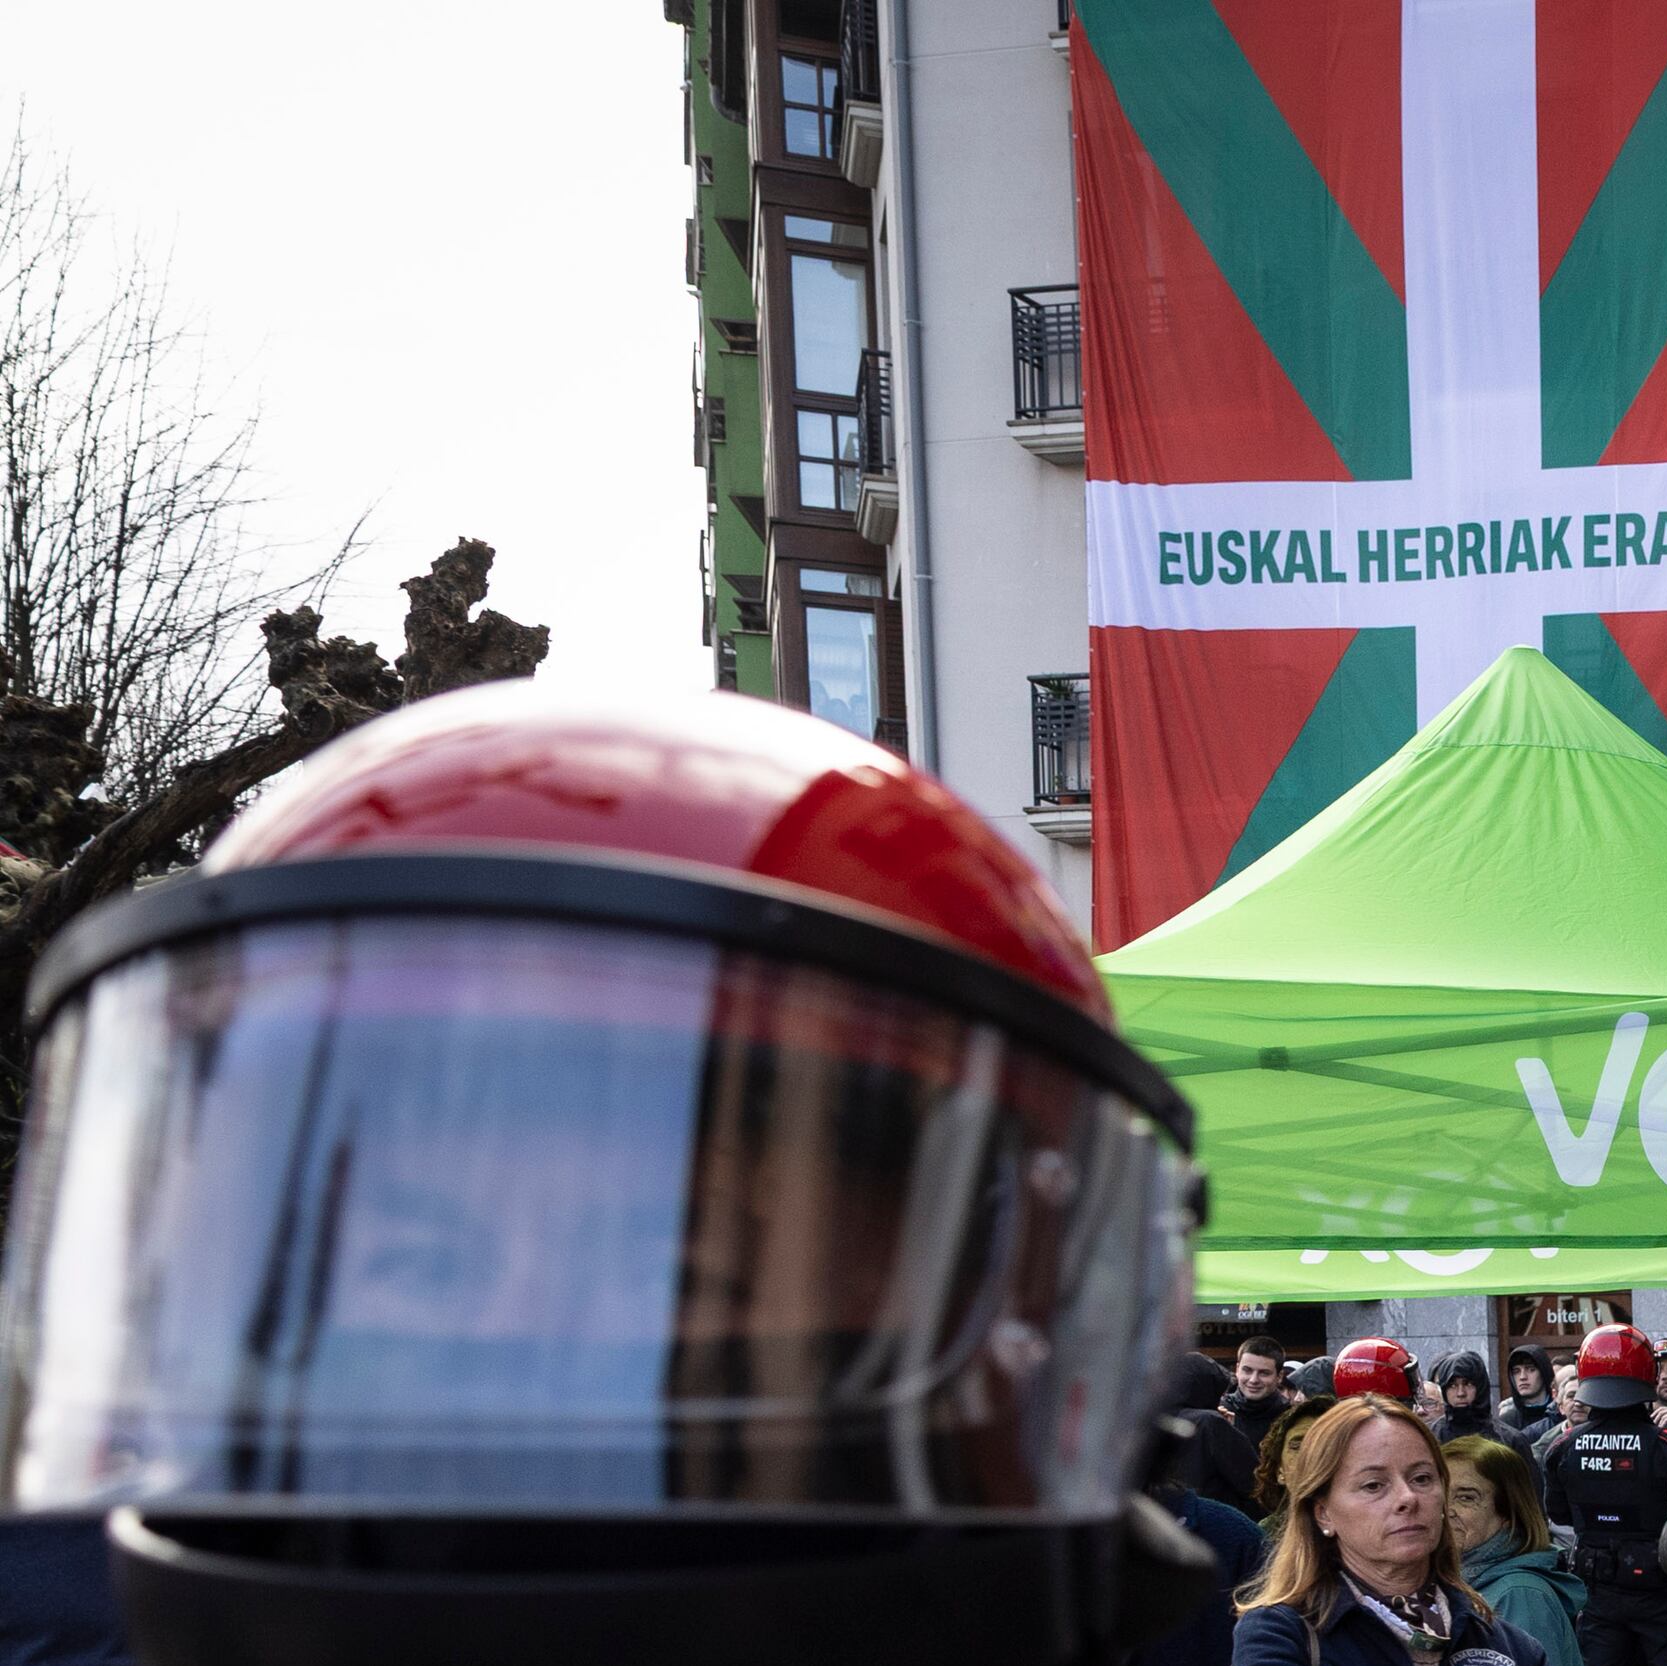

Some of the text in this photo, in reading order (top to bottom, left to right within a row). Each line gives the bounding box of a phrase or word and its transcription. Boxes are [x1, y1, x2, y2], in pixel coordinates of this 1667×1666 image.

[1159, 528, 1346, 586] EUSKAL
[1357, 514, 1572, 581] HERRIAK
[1547, 1308, 1589, 1323] biteri
[1575, 1434, 1641, 1451] ERTZAINTZA
[1581, 1456, 1612, 1471] F4R2
